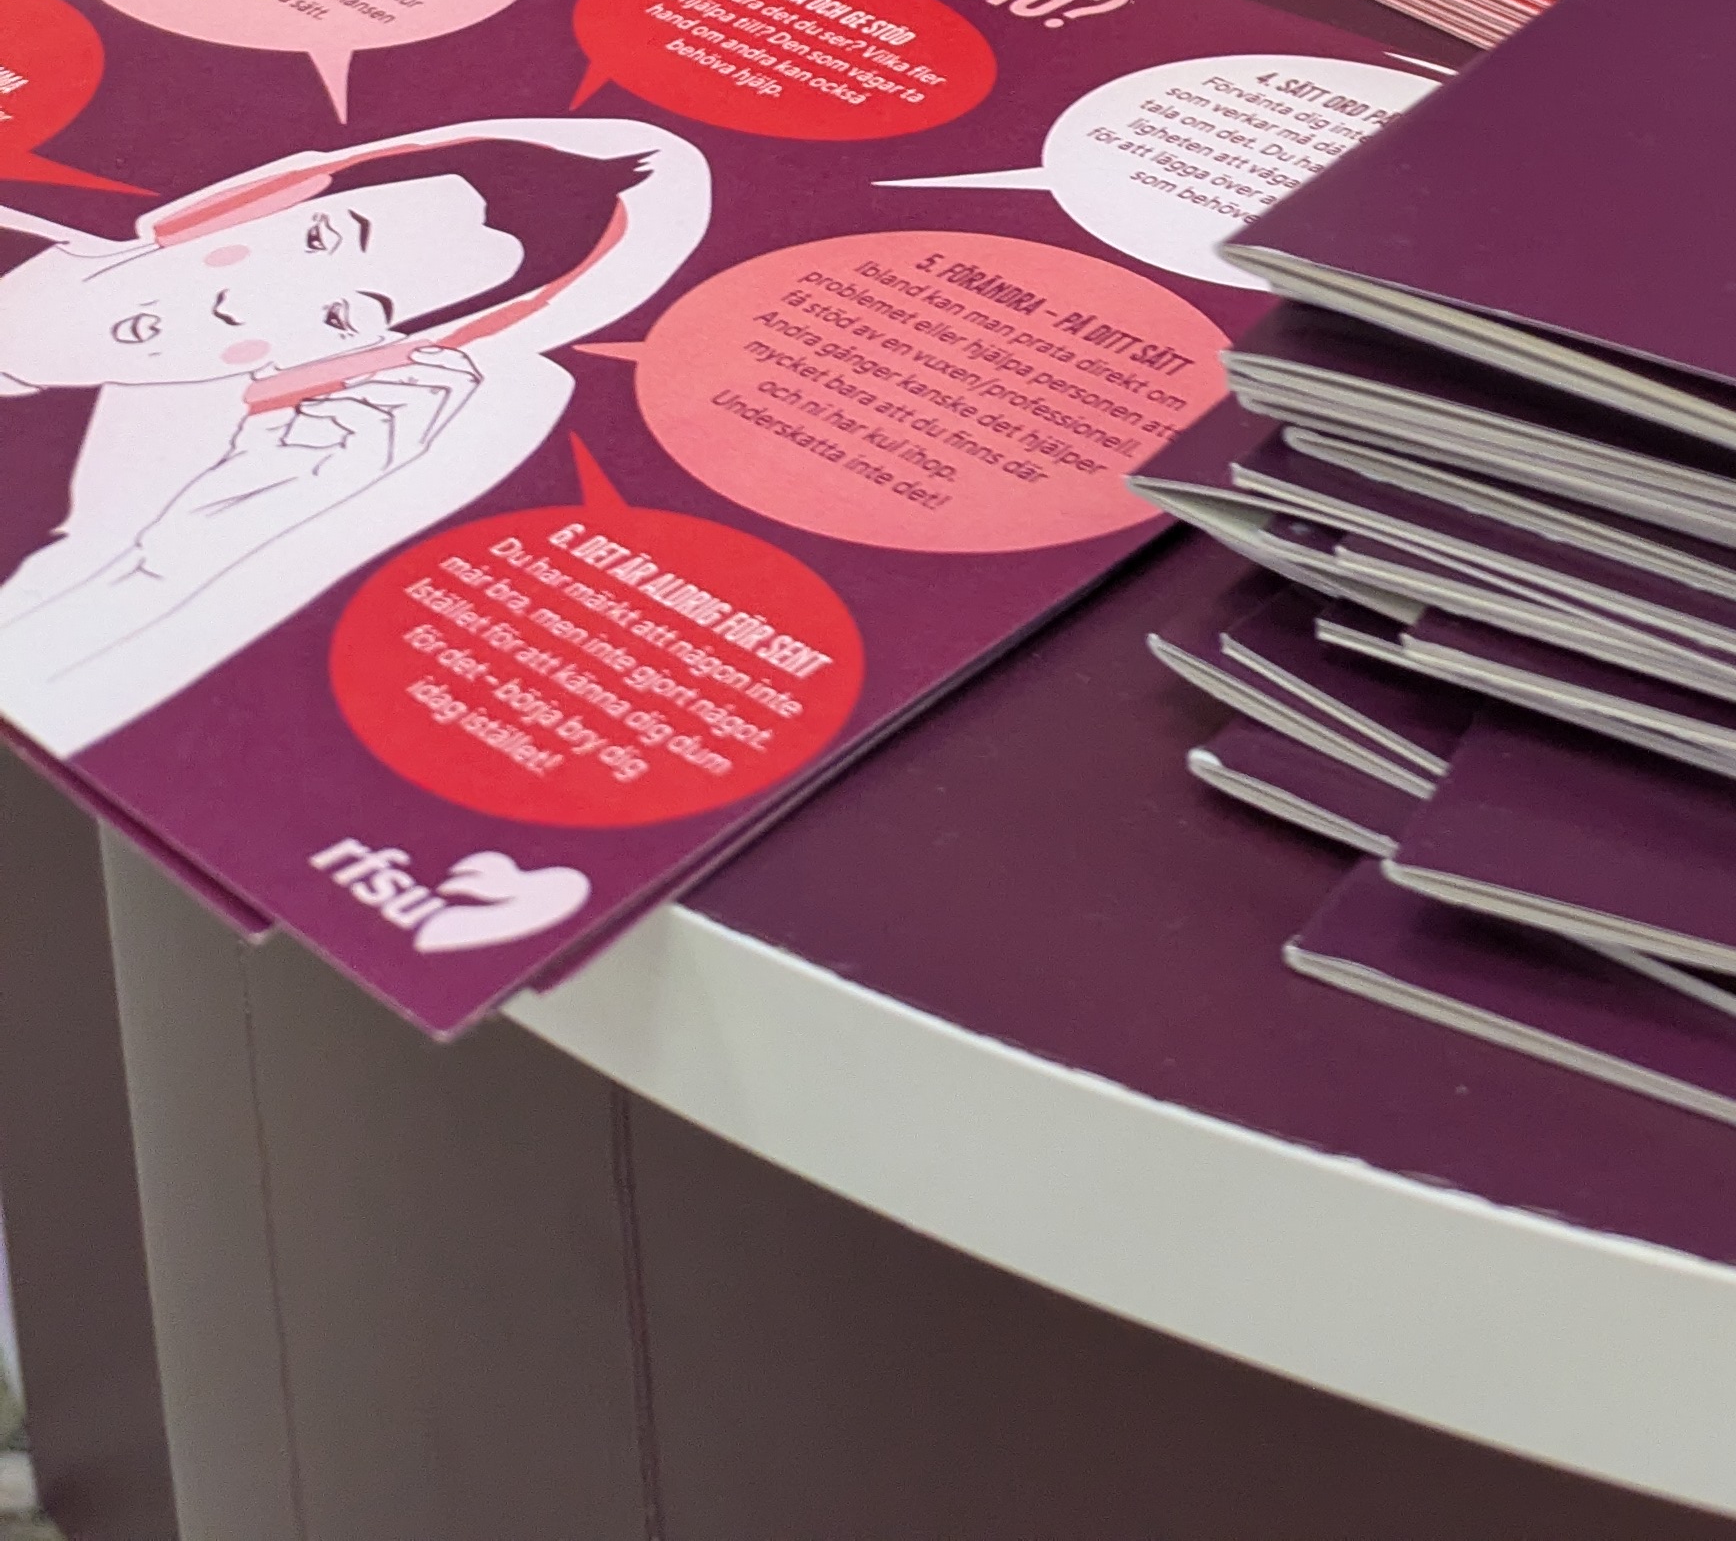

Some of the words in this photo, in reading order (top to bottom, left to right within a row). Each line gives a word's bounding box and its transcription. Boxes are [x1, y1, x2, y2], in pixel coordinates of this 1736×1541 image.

[646, 3, 700, 29] hand
[692, 27, 724, 43] om
[720, 39, 777, 66] andra
[774, 61, 812, 81] kan
[809, 78, 870, 104] också
[666, 39, 736, 74] behöva
[732, 68, 782, 97] hjälp.
[733, 18, 776, 36] till?
[767, 32, 810, 55] Den
[806, 51, 850, 71] som
[848, 67, 904, 93] vågar
[900, 89, 924, 102] ta
[761, 7, 799, 24] det
[794, 21, 823, 35] du
[818, 32, 867, 51] ser?
[862, 45, 910, 71] Vilka
[907, 66, 946, 85] fler
[840, 11, 875, 28] GE
[862, 21, 916, 45] STÖD
[1140, 100, 1180, 119] tala
[1180, 117, 1216, 133] om
[1216, 130, 1256, 149] det.
[1166, 88, 1211, 107] som
[1212, 104, 1279, 131] verkar
[1202, 77, 1294, 115] Förvänta
[1257, 73, 1278, 85] 4.
[1276, 79, 1331, 101] SÄTT
[1322, 96, 1370, 116] ORD
[1128, 119, 1214, 156] ligheten
[1151, 151, 1210, 179] lägga
[1130, 172, 1177, 193] som
[797, 272, 918, 324] problemet
[914, 321, 967, 345] eller
[962, 339, 1034, 377] hjälpa
[1026, 373, 1143, 426] personen
[854, 261, 931, 297] Ibland
[922, 290, 966, 315] kan
[962, 311, 1015, 337] man
[1007, 333, 1076, 363] prata
[1075, 359, 1150, 393] direkt
[1146, 390, 1187, 411] om
[916, 253, 944, 273] 5.
[936, 263, 1047, 315] FÖRÄNDRA
[1053, 312, 1097, 335] PÅ
[1082, 325, 1144, 353] DITT
[1130, 345, 1195, 375] SÄTT
[744, 341, 830, 382] mycket
[823, 375, 877, 406] bara
[874, 402, 916, 423] att
[911, 419, 946, 438] du
[943, 431, 1004, 465] finns
[1002, 461, 1048, 482] där
[753, 312, 822, 347] Andra
[814, 343, 902, 380] gånger
[896, 374, 978, 417] kanske
[977, 414, 1025, 438] det
[1018, 429, 1108, 474] hjälper
[781, 290, 812, 307] få
[802, 303, 862, 329] stöd
[852, 325, 885, 340] av
[881, 339, 913, 355] en
[913, 351, 1142, 458] vuxen/professionell.
[711, 390, 846, 463] Underskatta
[844, 455, 894, 485] inte
[892, 482, 950, 510] det!
[758, 381, 802, 405] och
[798, 401, 834, 416] ni
[822, 409, 868, 433] har
[862, 427, 909, 452] kul
[898, 445, 956, 482] ihop.
[549, 523, 584, 548] 6.
[570, 535, 630, 569] DET
[608, 553, 658, 585] ÄR
[638, 573, 732, 626] ALDRIG
[712, 612, 775, 649] FÖR
[756, 635, 832, 678] SENT
[459, 708, 563, 774] istället!
[310, 838, 452, 935] rfsu
